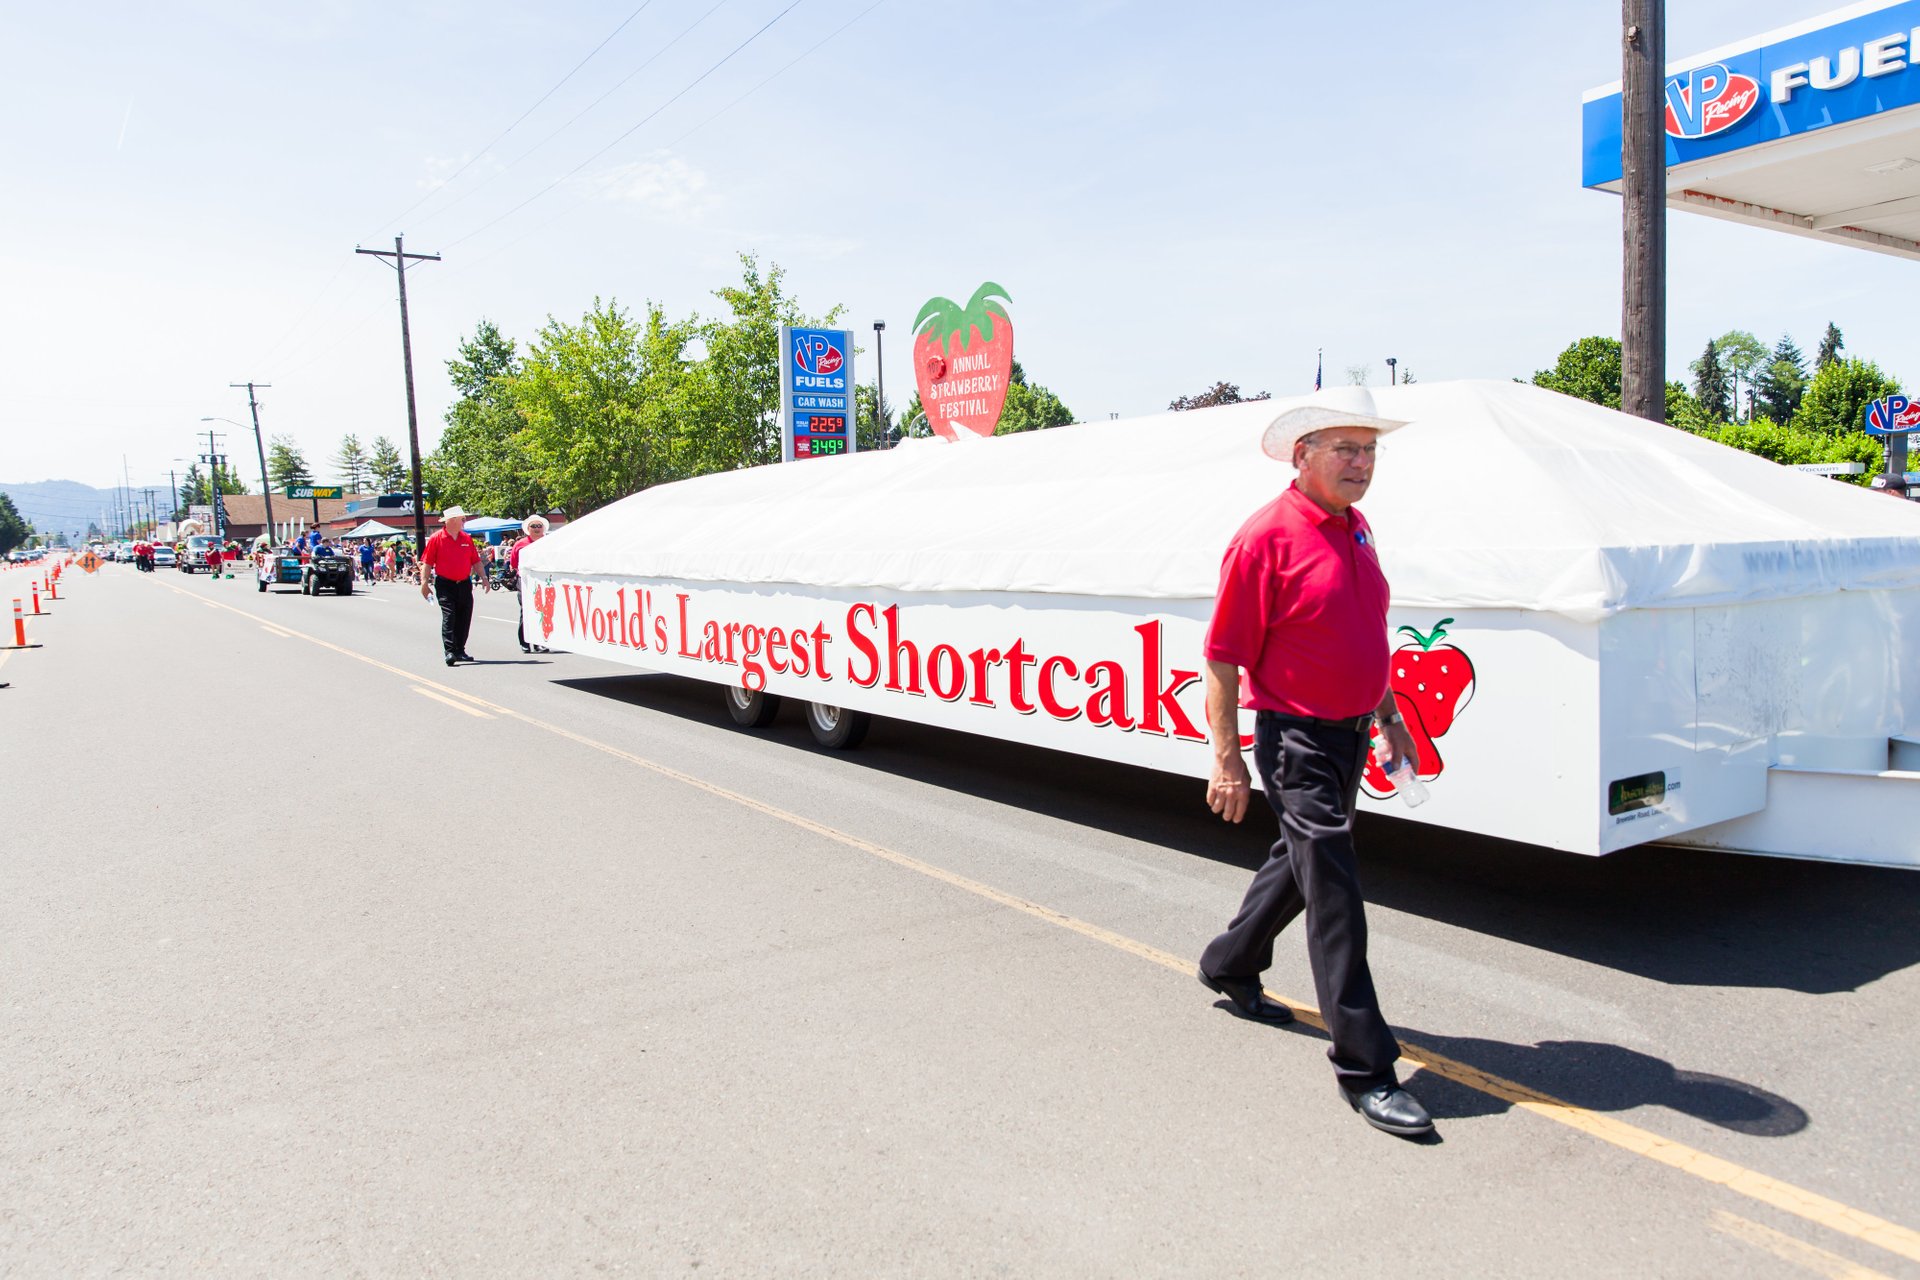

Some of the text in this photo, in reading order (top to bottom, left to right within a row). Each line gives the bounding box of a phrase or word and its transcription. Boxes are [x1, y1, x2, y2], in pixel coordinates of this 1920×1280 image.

[1665, 63, 1730, 138] VP
[1705, 91, 1752, 126] Racing
[796, 335, 829, 374] VP
[818, 356, 842, 369] Racing
[952, 353, 991, 374] ANNUAL
[795, 376, 844, 389] FUELS
[930, 375, 998, 400] STRAWBERRY
[798, 397, 844, 408] CAR WASH
[940, 398, 989, 419] FESTIVAL
[1872, 395, 1909, 430] VP
[292, 488, 337, 498] SUBWAY
[562, 584, 1255, 751] World's Largest Shortcak
